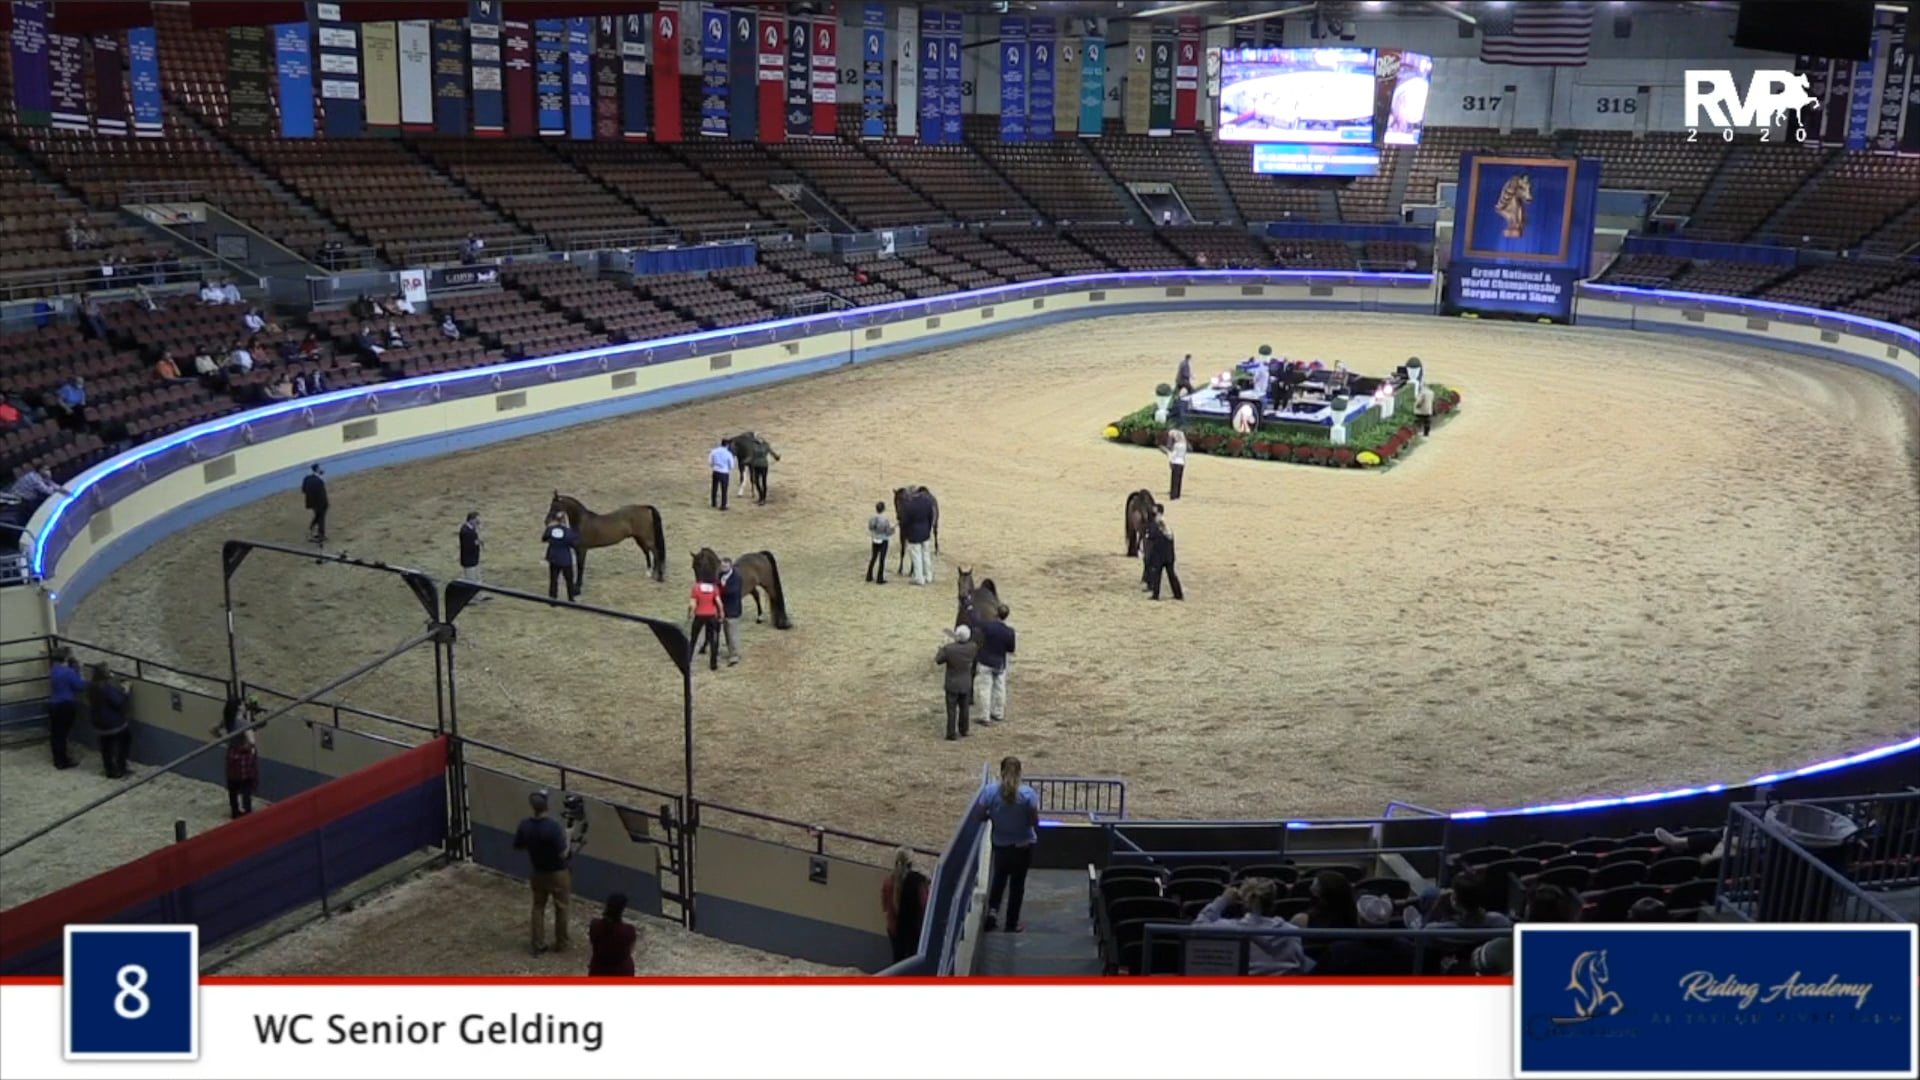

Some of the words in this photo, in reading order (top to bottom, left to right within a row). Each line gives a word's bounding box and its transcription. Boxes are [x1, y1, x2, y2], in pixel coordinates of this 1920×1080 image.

[1462, 96, 1502, 111] 317
[1596, 98, 1637, 114] 318
[1471, 268, 1501, 278] Grand
[1502, 269, 1543, 282] National
[1544, 273, 1552, 282] &
[1461, 277, 1489, 288] World
[1491, 279, 1561, 294] Championship
[1462, 288, 1498, 299] Morgan
[1499, 290, 1527, 301] Horse
